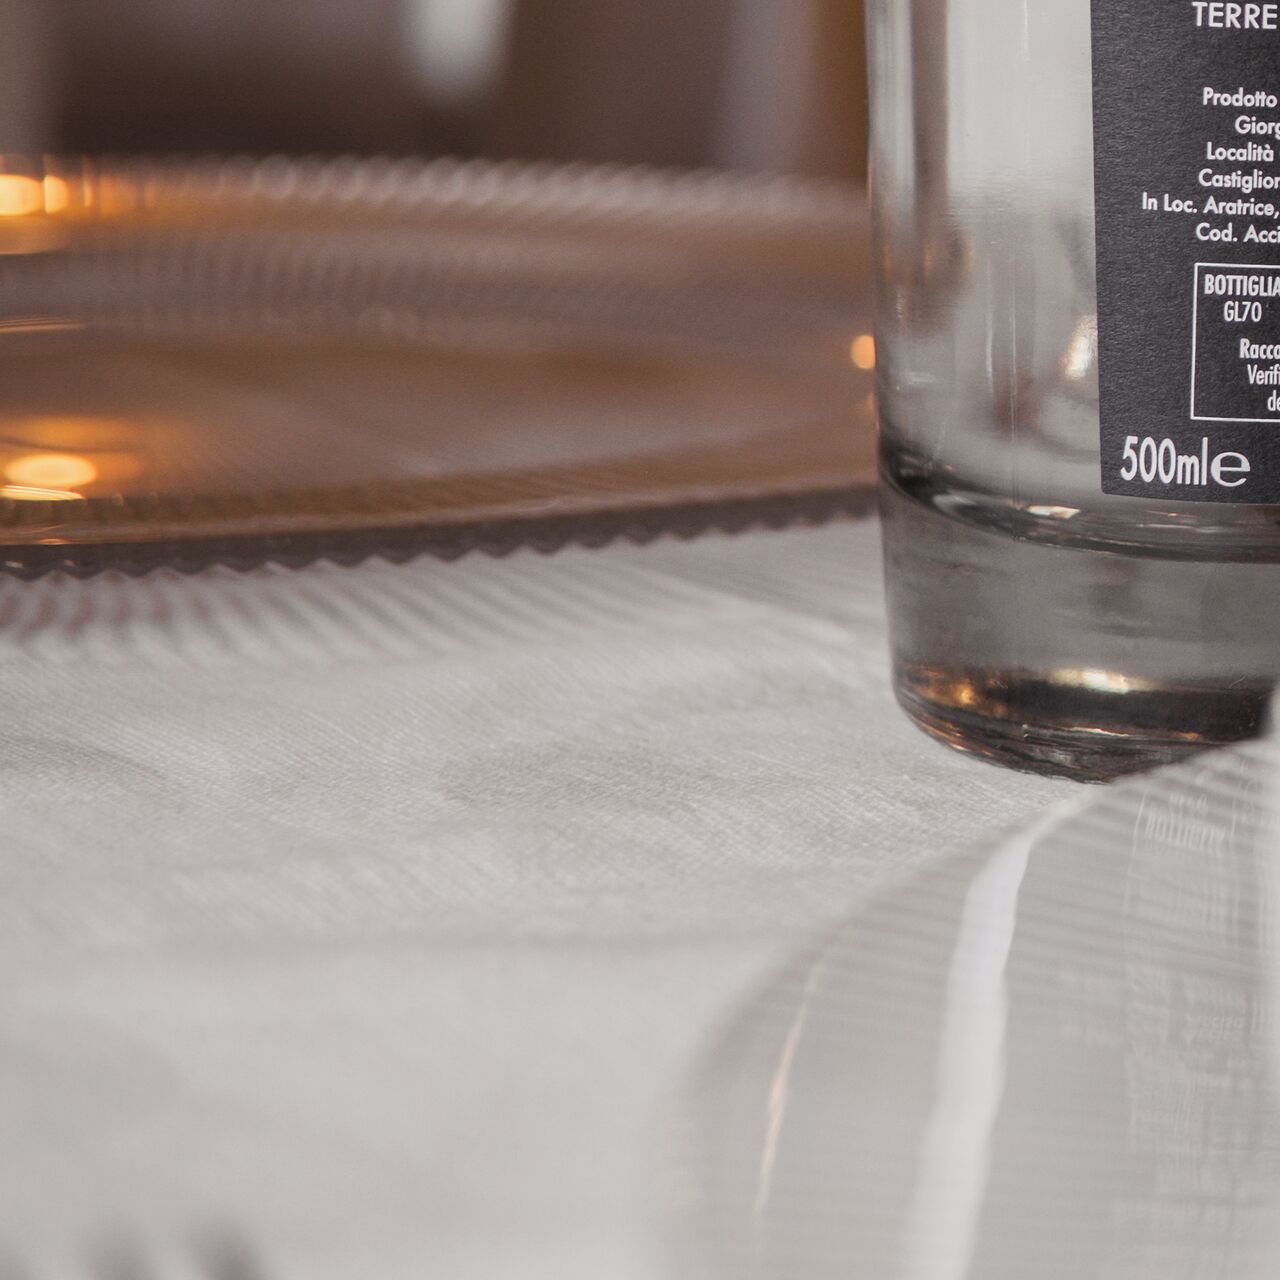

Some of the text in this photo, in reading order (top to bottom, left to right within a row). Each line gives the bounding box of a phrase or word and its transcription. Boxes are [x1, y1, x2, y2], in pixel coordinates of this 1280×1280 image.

[1190, 0, 1278, 30] TERRE
[1202, 86, 1278, 108] Prodotto
[1205, 141, 1275, 162] Località
[1141, 191, 1159, 211] In
[1162, 192, 1198, 214] Loc.
[1202, 195, 1280, 220] Aratrice,
[1195, 221, 1238, 243] Cod.
[1223, 300, 1263, 323] GL70
